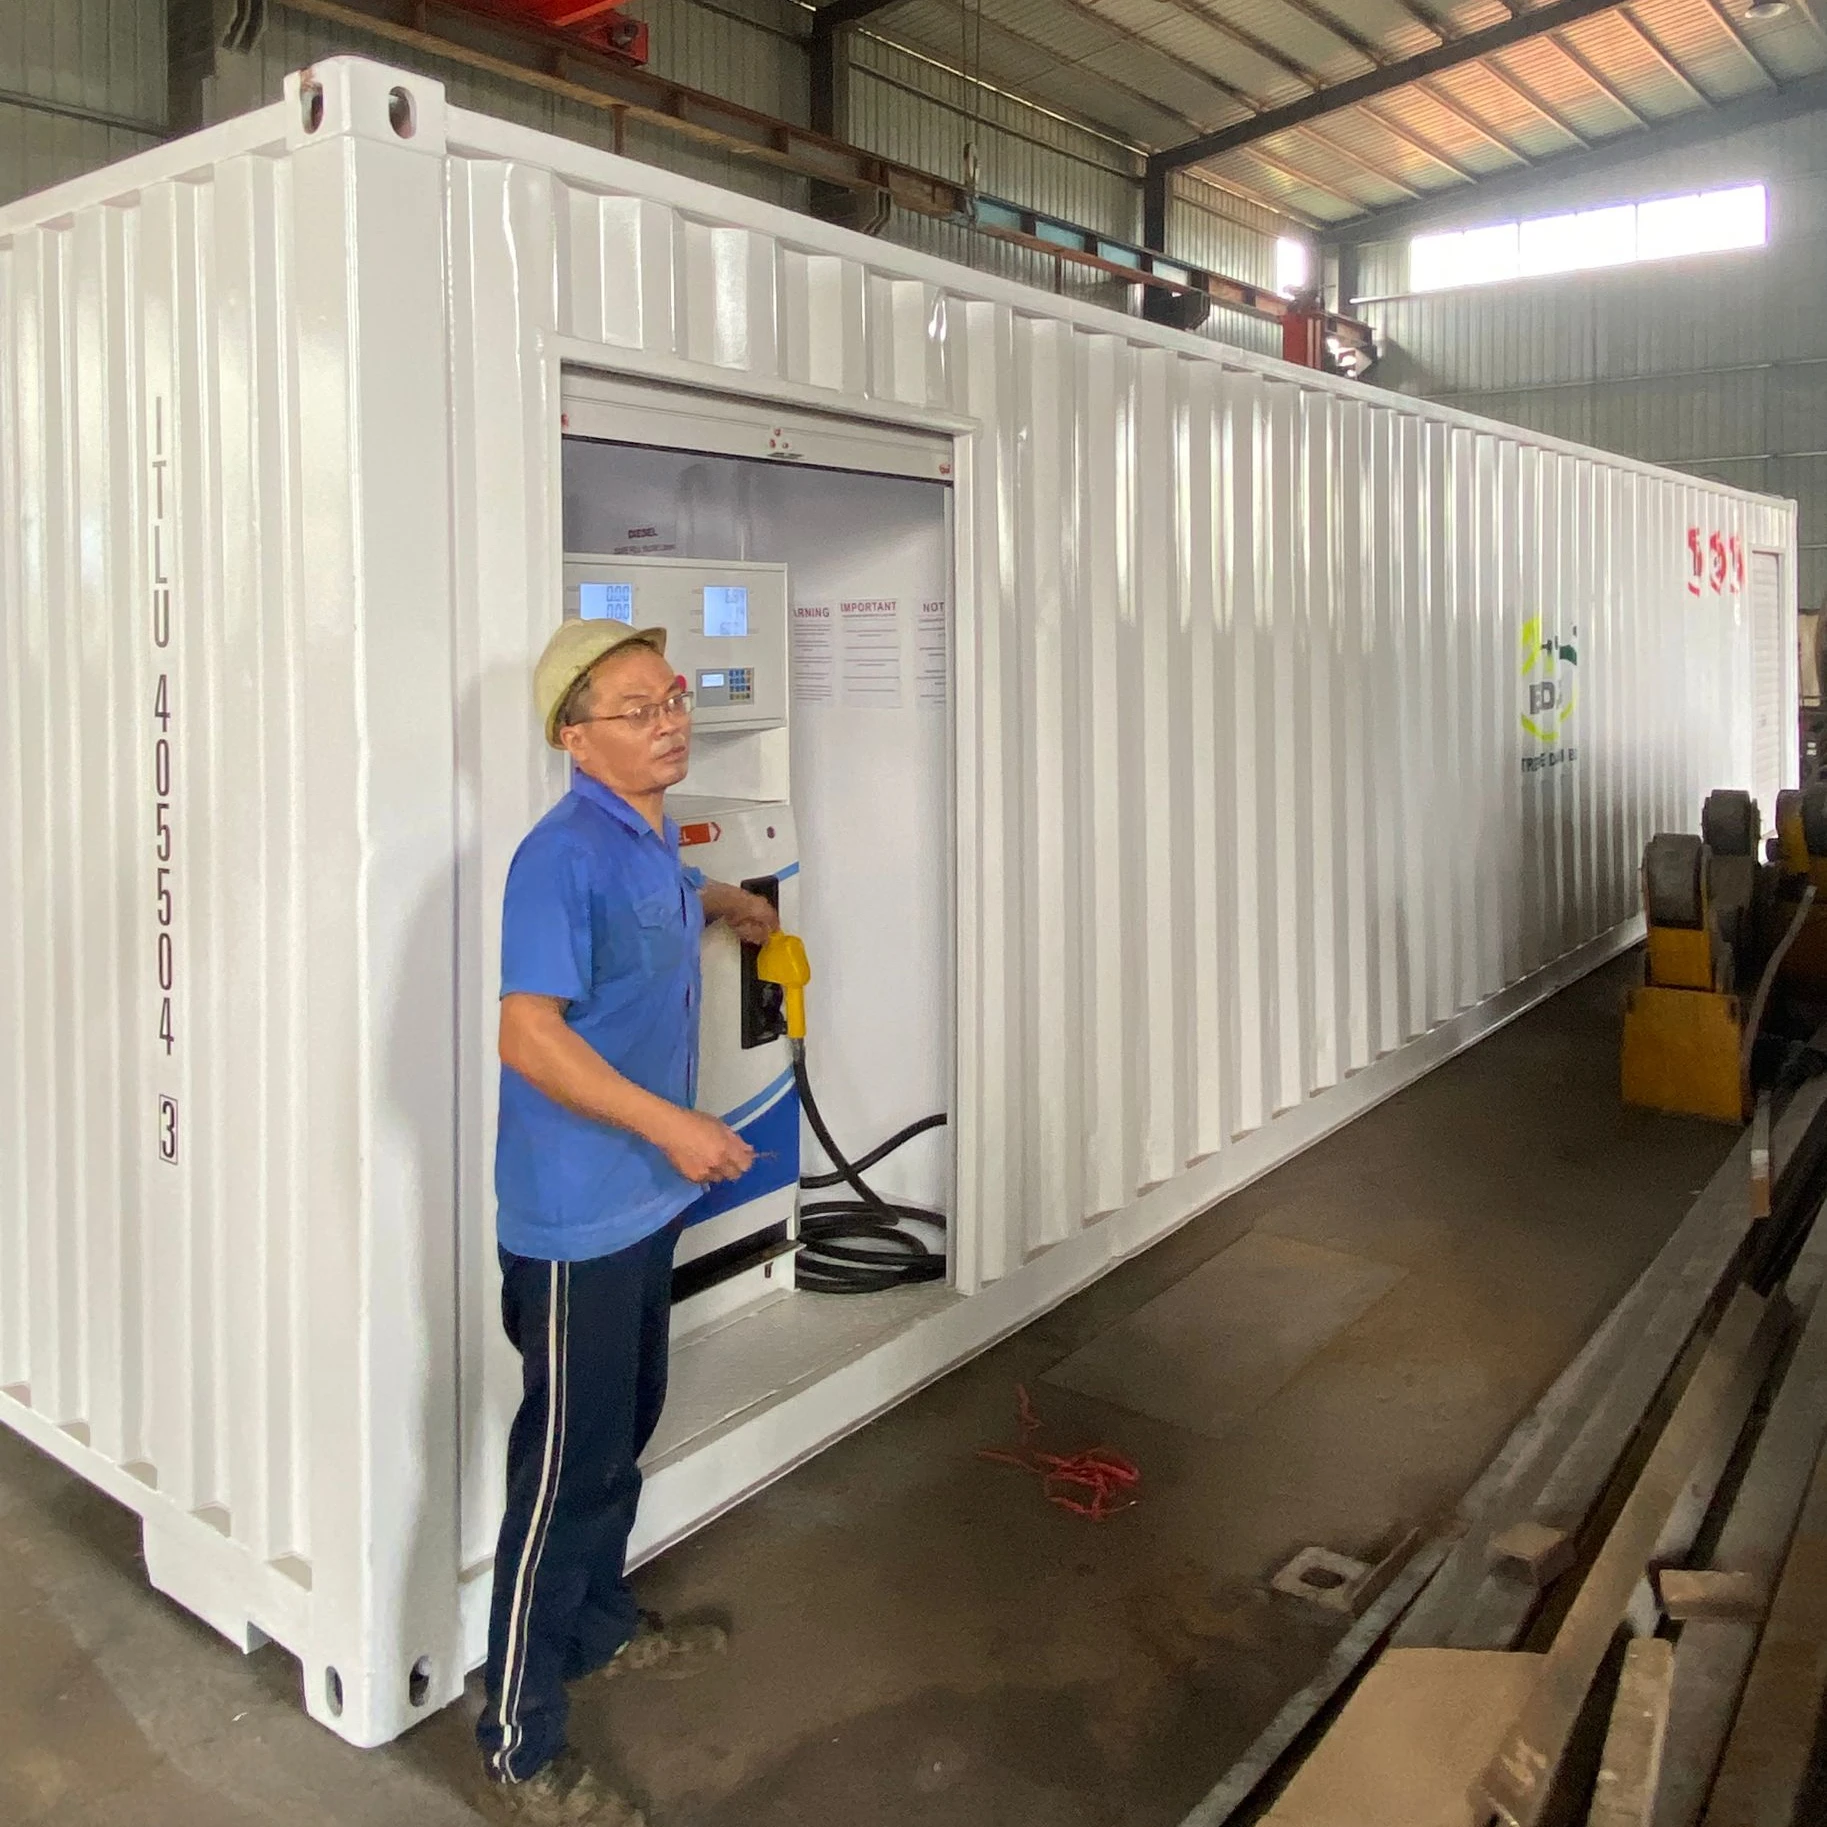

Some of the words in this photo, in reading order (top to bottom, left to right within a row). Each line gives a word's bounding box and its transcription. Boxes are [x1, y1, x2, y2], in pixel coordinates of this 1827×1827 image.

[840, 601, 897, 613] IMPORTANT
[154, 673, 174, 1056] 405504
[160, 1098, 177, 1161] 3
